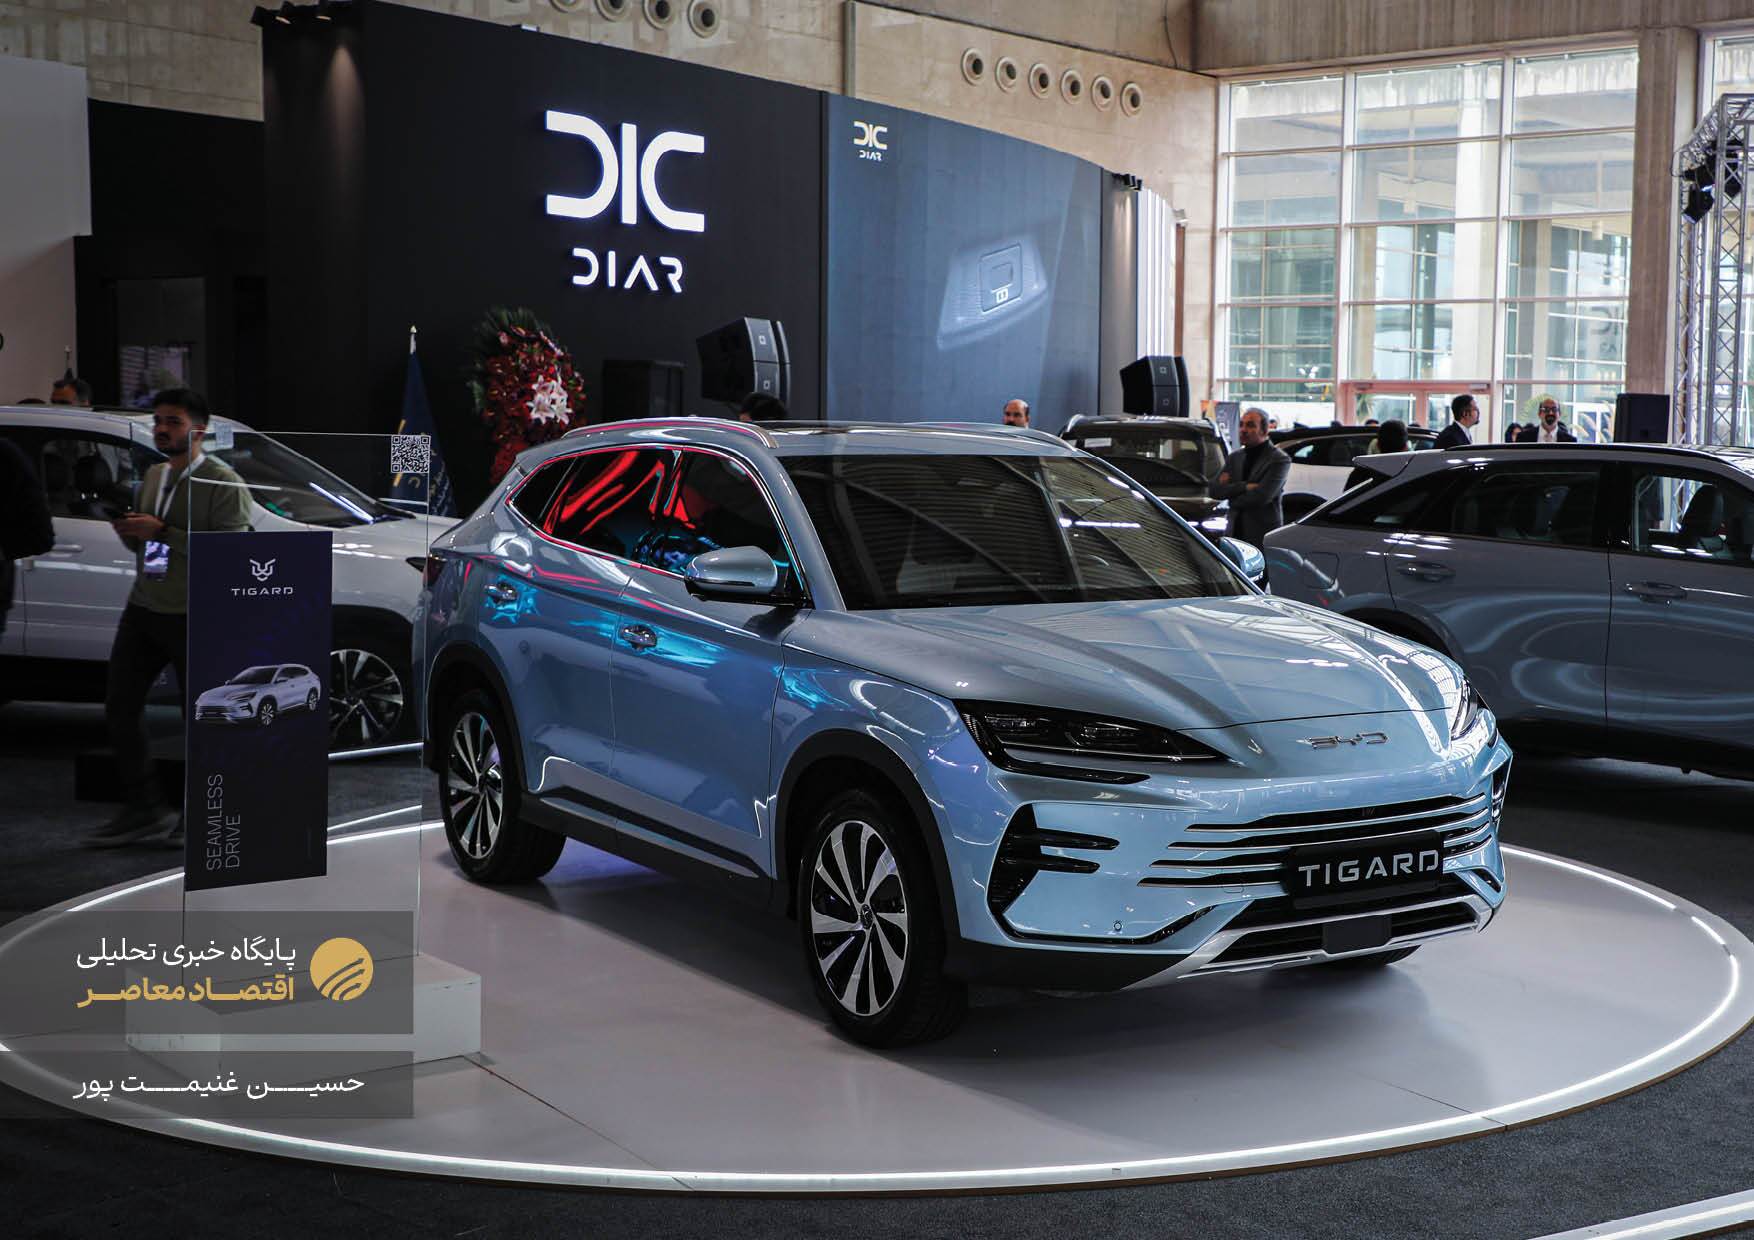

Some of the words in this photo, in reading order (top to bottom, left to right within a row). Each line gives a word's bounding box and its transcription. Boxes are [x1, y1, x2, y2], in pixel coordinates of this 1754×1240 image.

[859, 149, 882, 161] DIAR
[572, 247, 683, 293] DIAR
[231, 586, 294, 597] TIGARD
[1307, 731, 1388, 749] BYD
[206, 773, 224, 871] SEAMLESS
[225, 814, 241, 868] DRIVE
[1297, 849, 1440, 888] TIGARD
